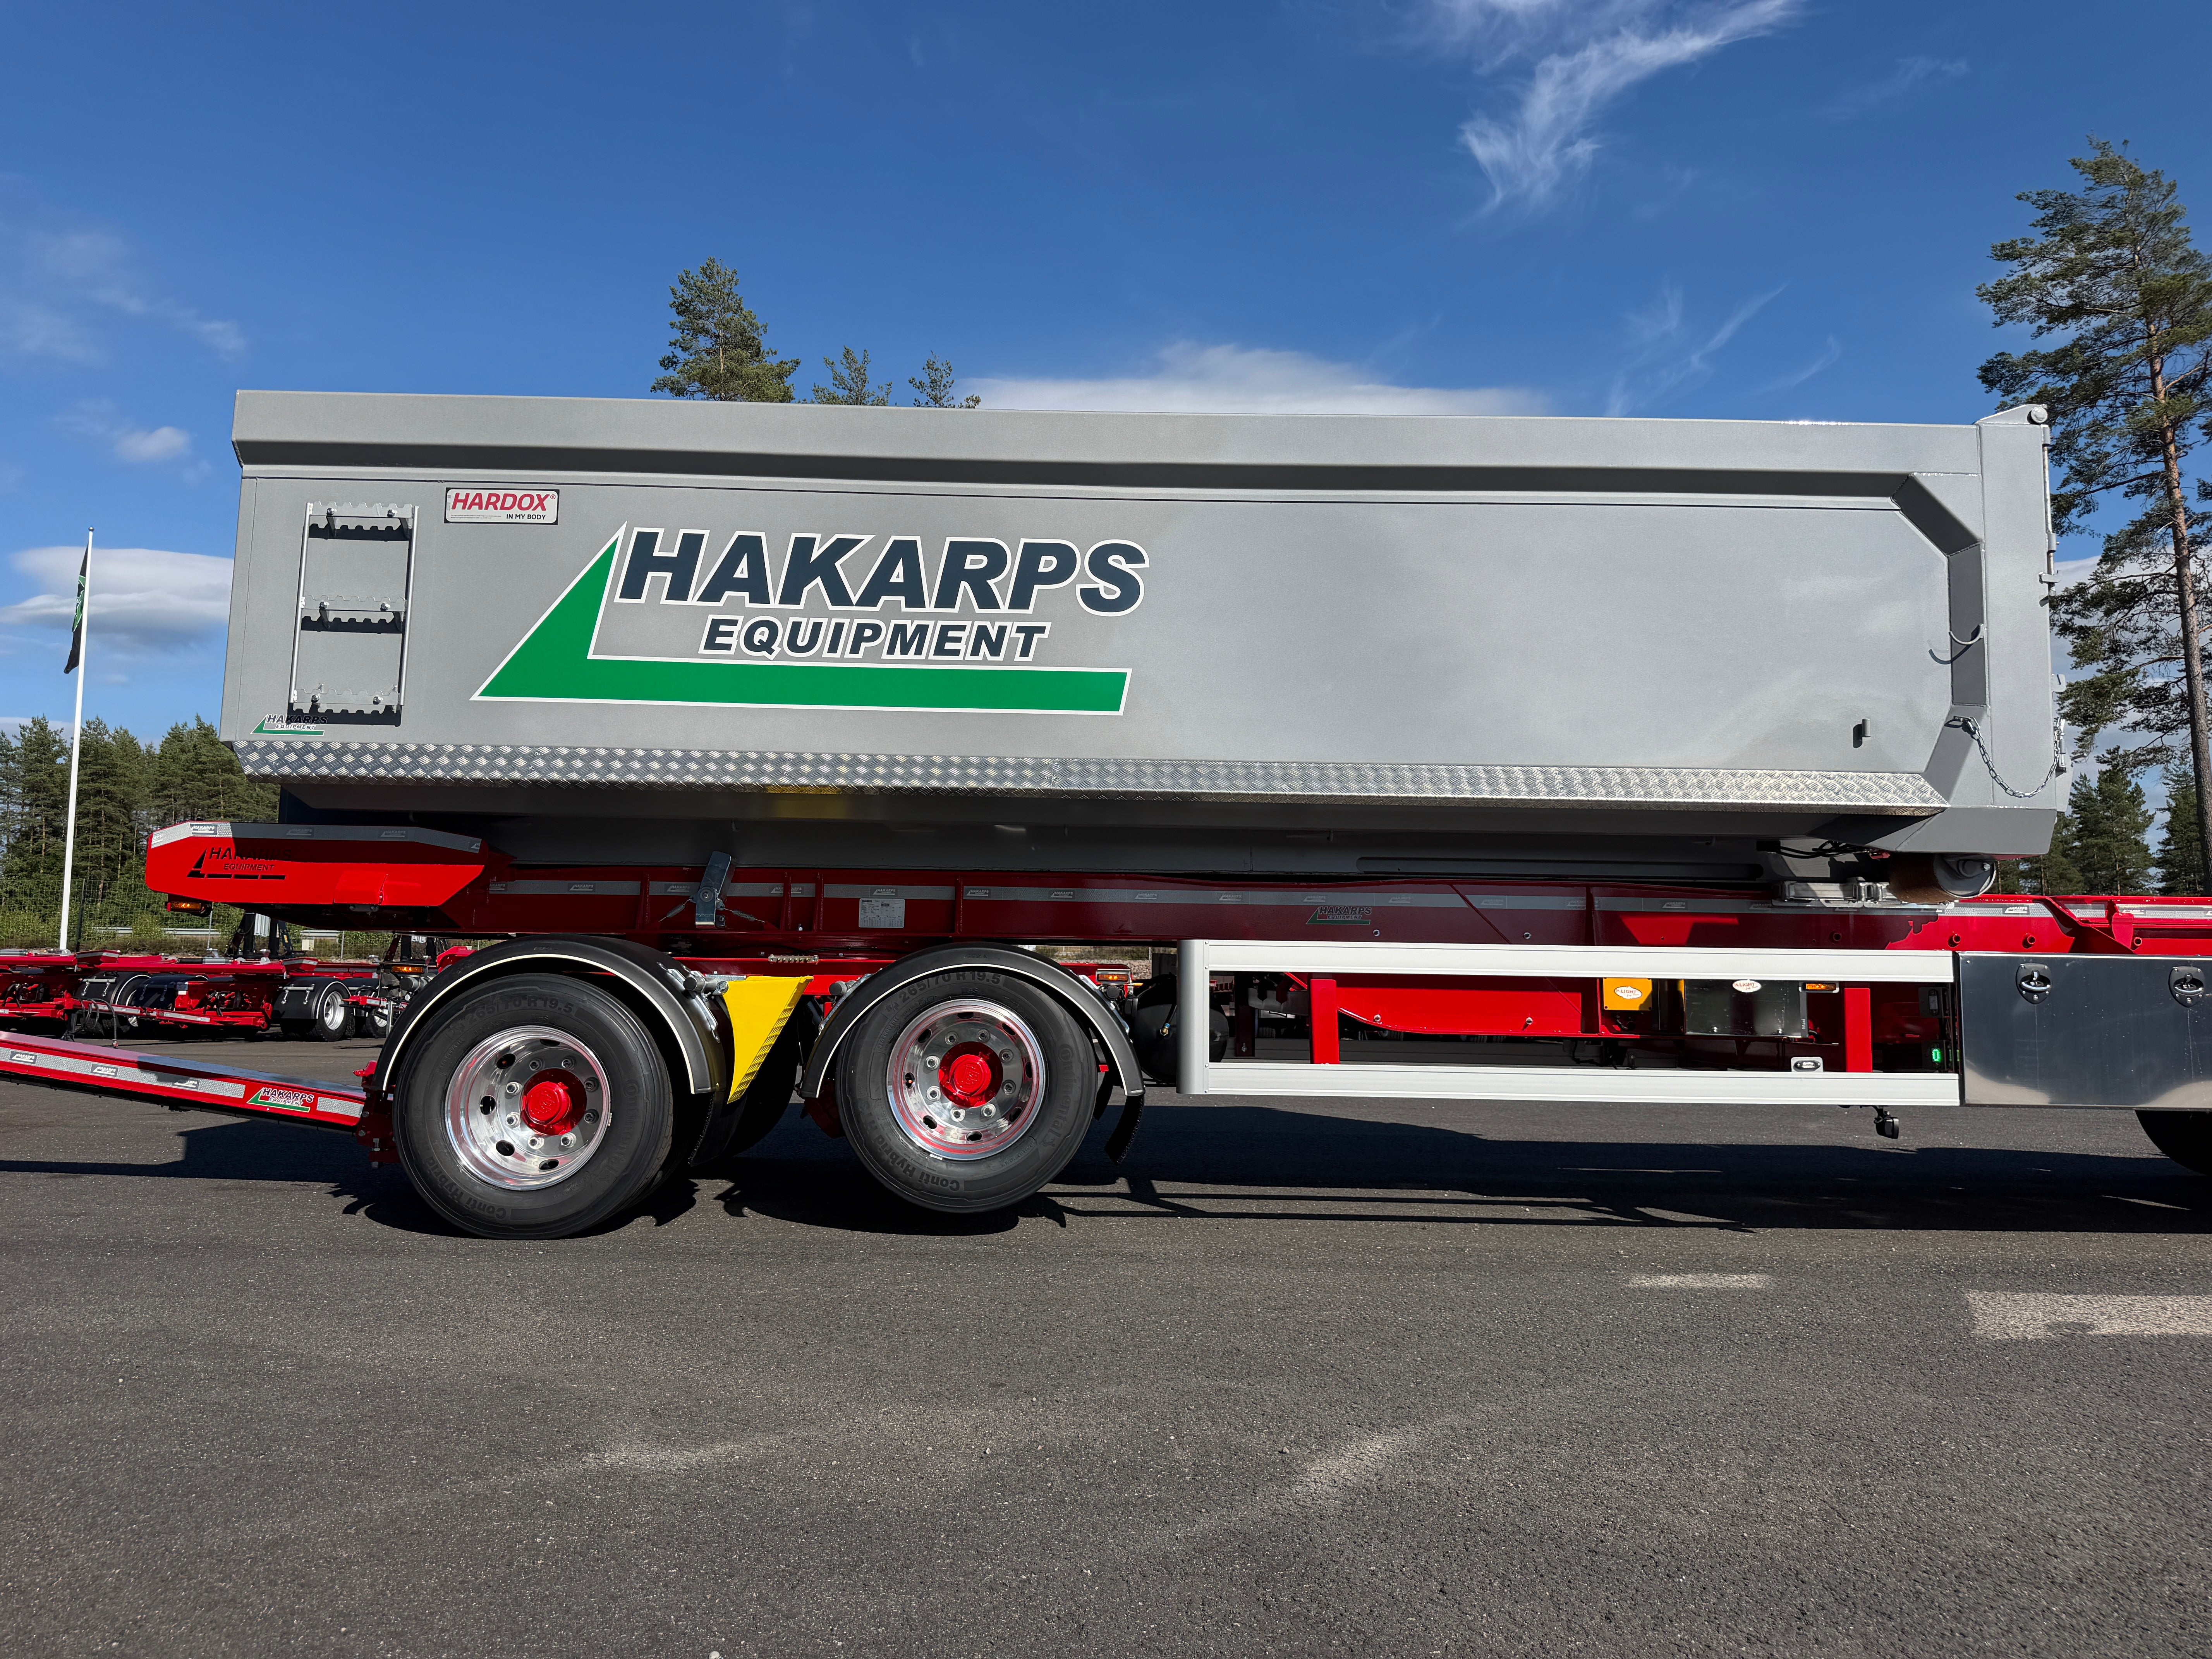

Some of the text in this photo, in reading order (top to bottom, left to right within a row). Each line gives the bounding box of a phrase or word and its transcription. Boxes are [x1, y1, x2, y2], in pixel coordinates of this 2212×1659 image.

[613, 527, 1150, 617] HAKARPS
[698, 614, 1052, 662] EQUIPMENT
[266, 714, 328, 724] HAKARPS
[208, 846, 292, 861] HAKARPS
[223, 863, 275, 871] EQUIPMENT
[1319, 906, 1372, 915] HAKARPS
[956, 972, 966, 981] R
[969, 971, 1001, 984] 19.5
[527, 994, 537, 1007] R
[543, 996, 574, 1013] 19.5
[261, 1087, 314, 1103] HAKARPS
[268, 1096, 304, 1106] EQUIPMENT
[873, 1134, 917, 1178] Hybrid
[426, 1155, 464, 1202] Hybrid
[918, 1171, 960, 1192] Conti
[465, 1197, 507, 1219] Conti
